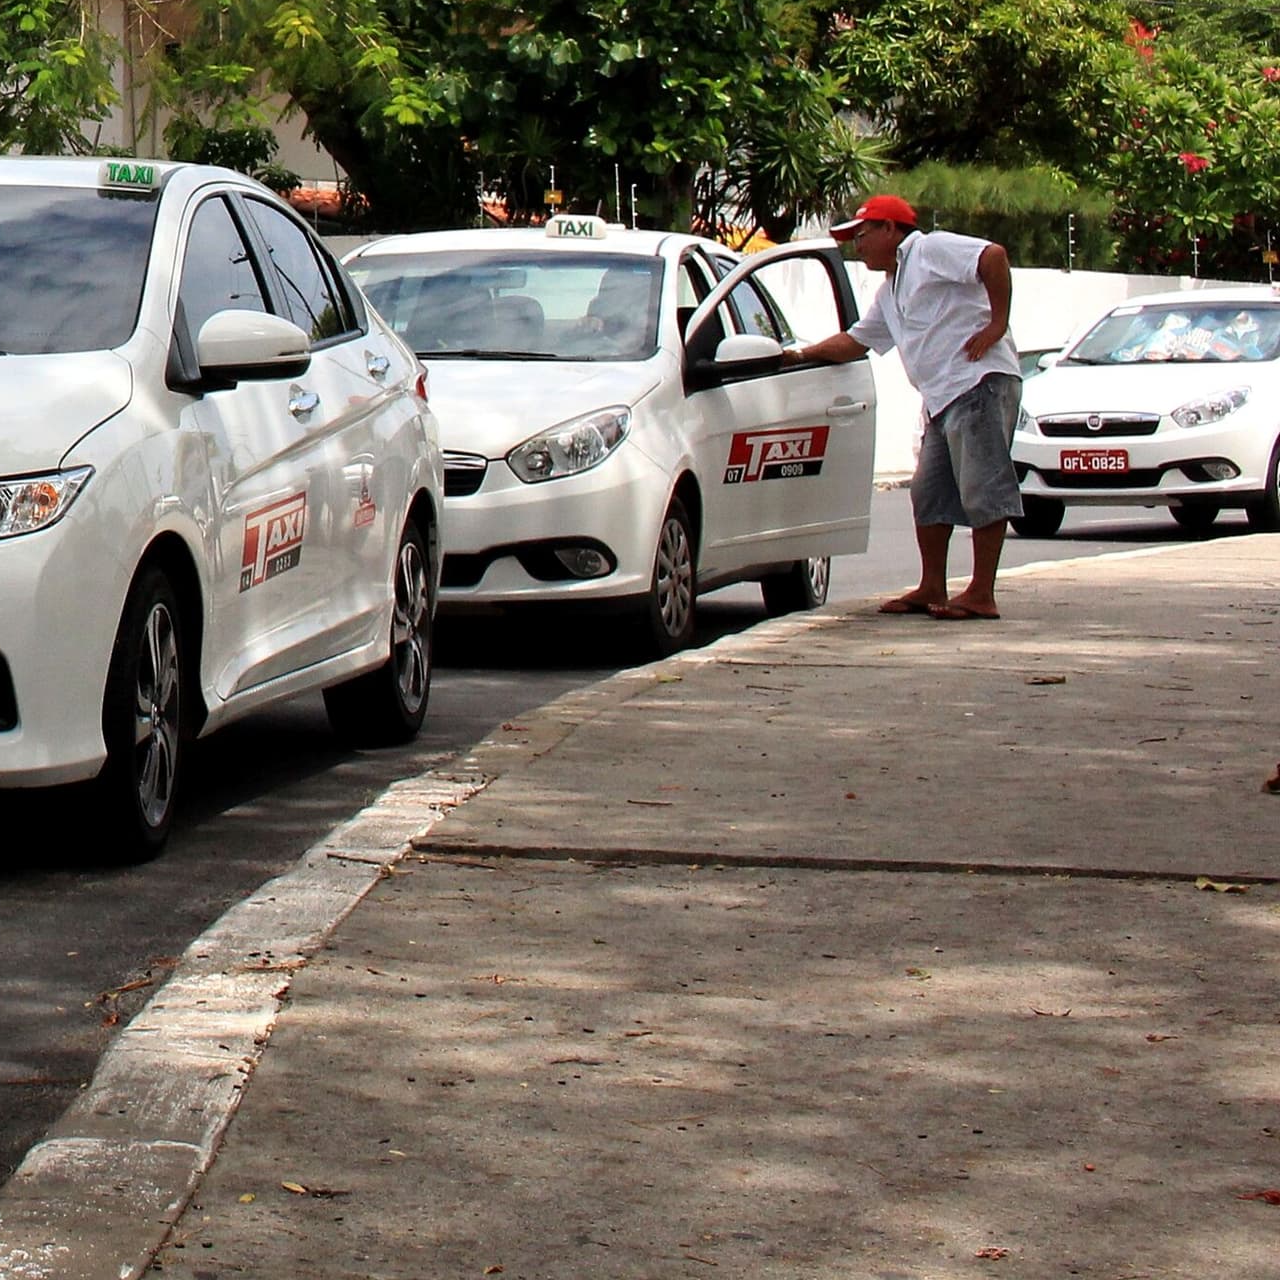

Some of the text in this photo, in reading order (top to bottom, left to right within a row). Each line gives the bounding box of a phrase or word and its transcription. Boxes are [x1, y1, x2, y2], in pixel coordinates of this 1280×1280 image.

[107, 163, 154, 185] TAXI
[554, 219, 593, 237] TAXI
[745, 432, 813, 476] TAXI
[727, 469, 740, 482] 07
[780, 463, 804, 477] 0909
[247, 497, 305, 581] TAXI
